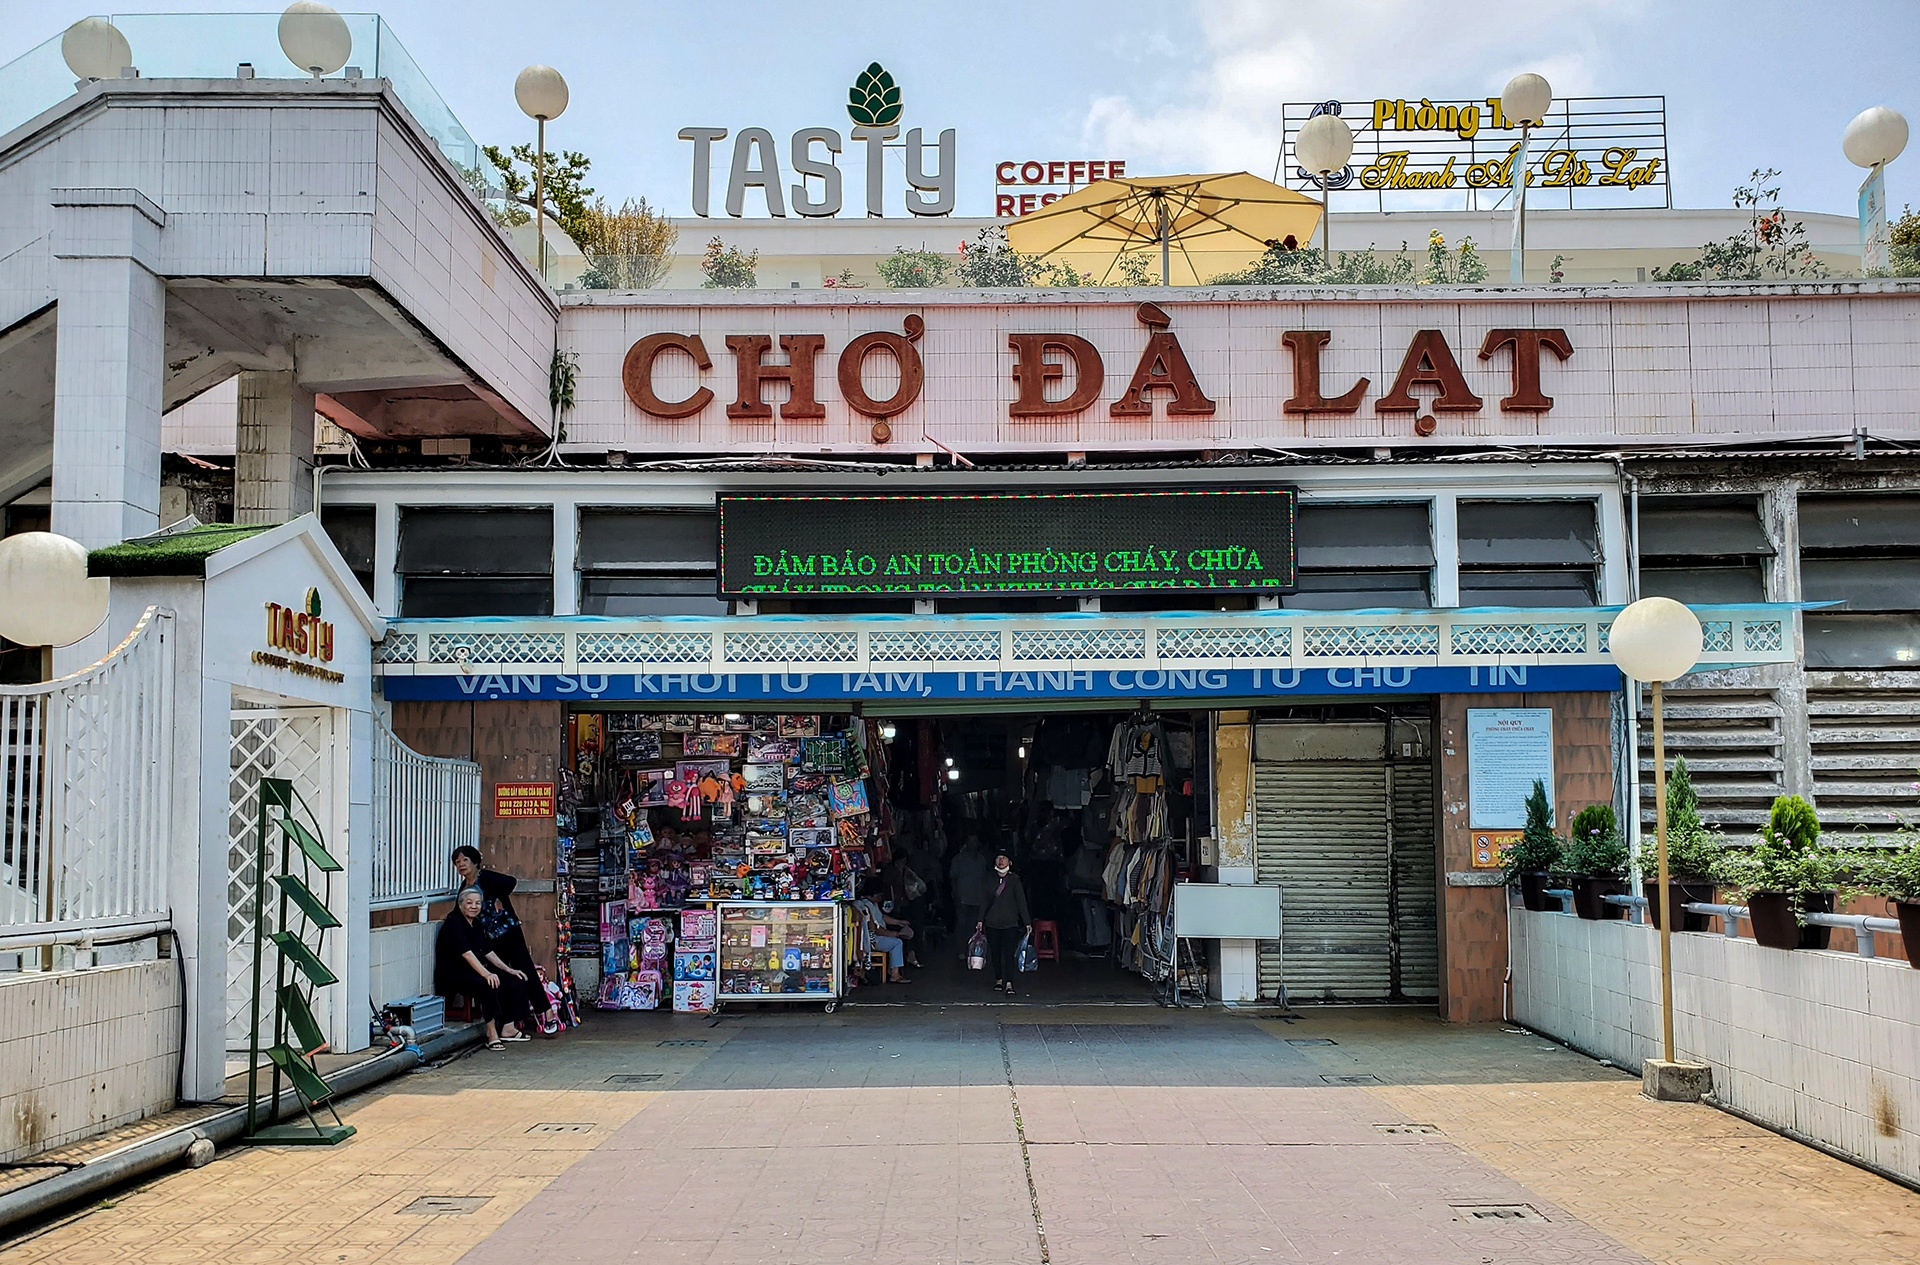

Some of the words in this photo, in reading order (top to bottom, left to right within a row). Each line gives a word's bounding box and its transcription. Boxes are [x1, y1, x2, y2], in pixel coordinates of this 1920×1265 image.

[1373, 98, 1480, 139] Phòng
[996, 161, 1126, 184] COFFEE
[1360, 150, 1457, 189] Thanh
[1542, 149, 1592, 187] Đà
[1599, 147, 1661, 191] Lạt
[622, 313, 925, 444] CHỢ
[1008, 301, 1216, 417] ĐÀ
[1282, 328, 1575, 436] LẠT
[753, 549, 817, 576] ĐẢM
[821, 548, 877, 576] BẢO
[884, 553, 923, 575] AN
[929, 547, 1001, 575] TOÀN
[1007, 546, 1098, 574] PHÒNG
[1104, 545, 1181, 575] CHÁY,
[1187, 544, 1264, 571] CHỮA
